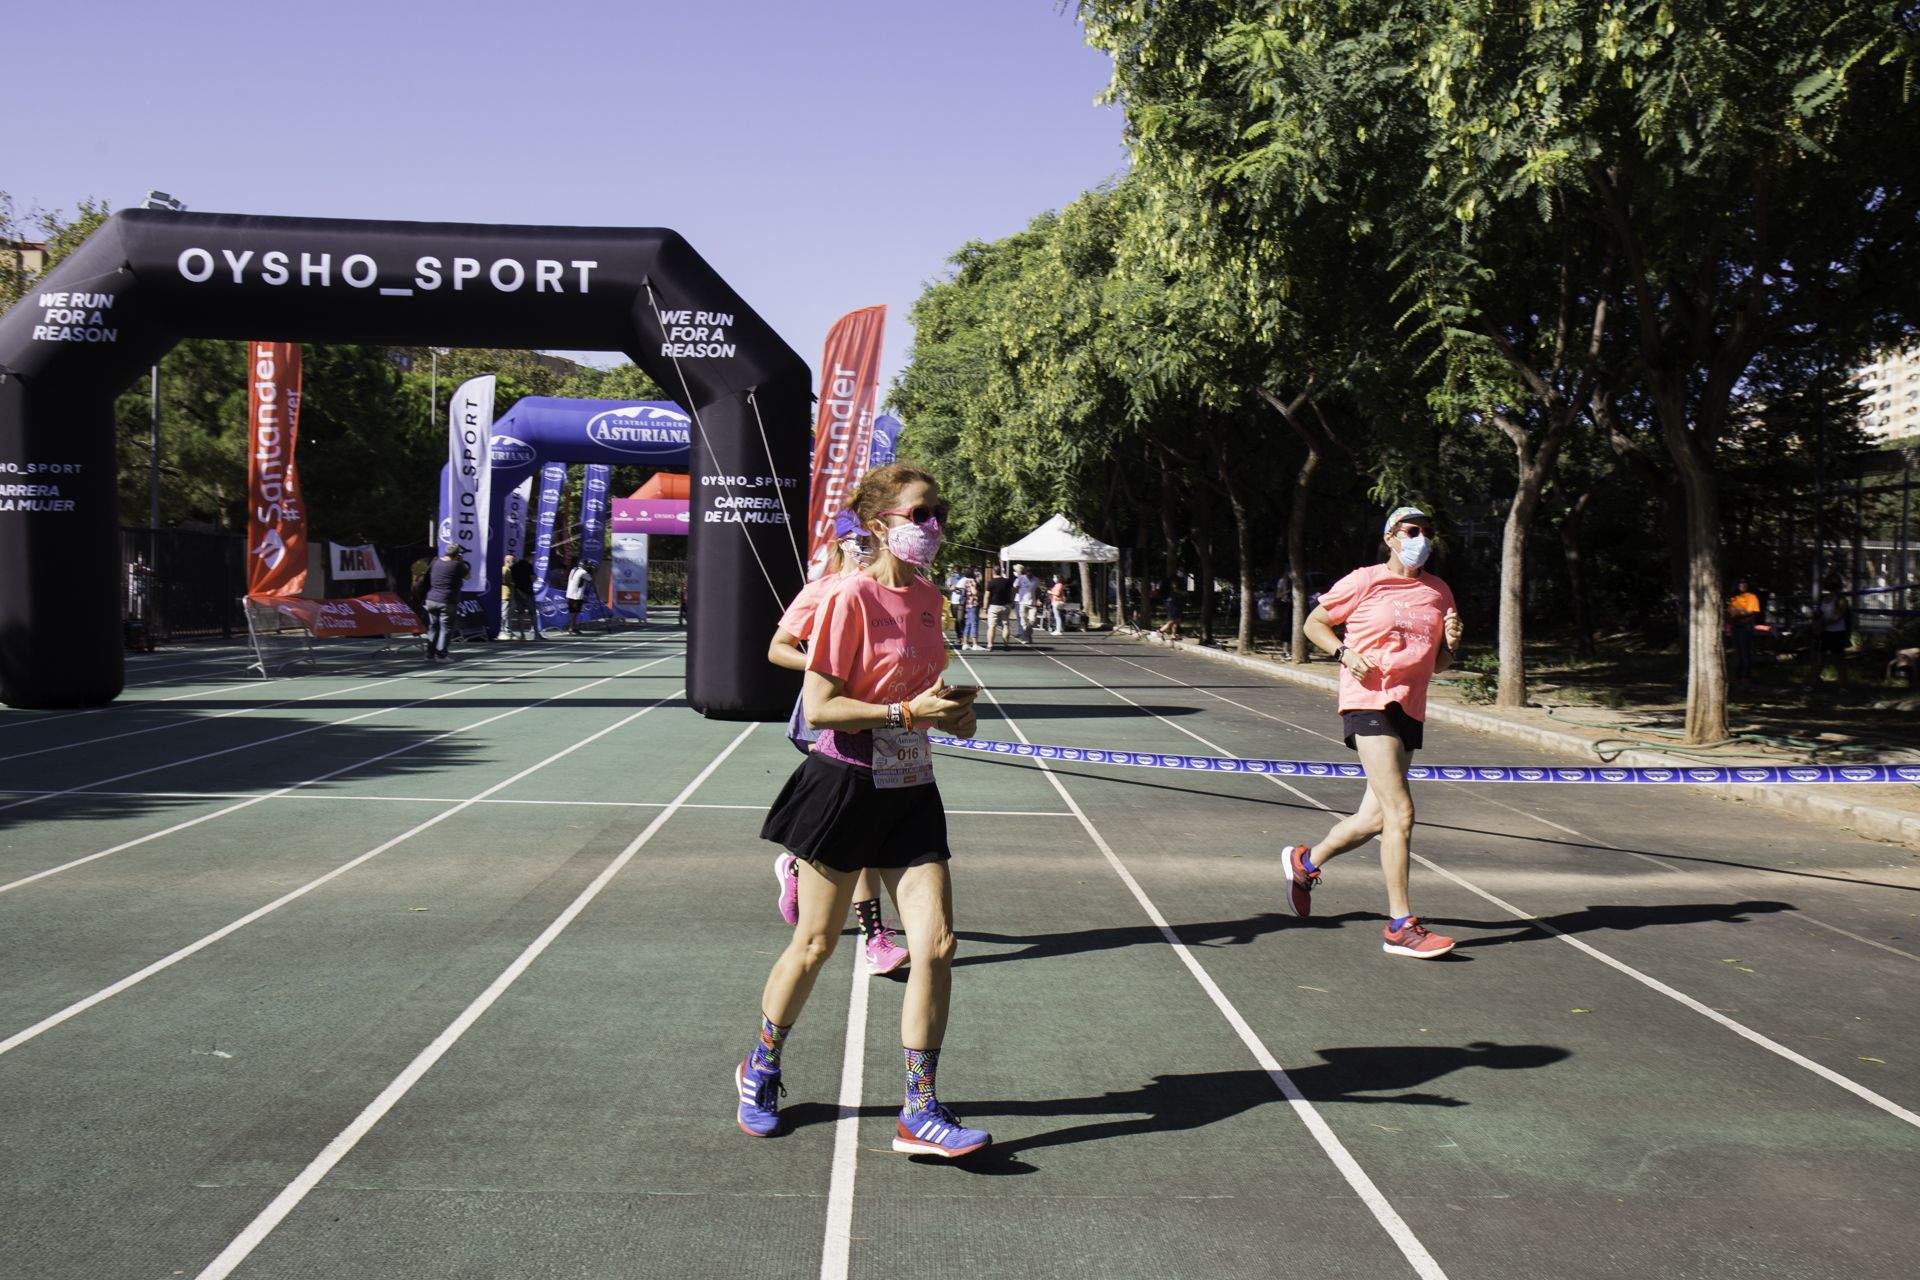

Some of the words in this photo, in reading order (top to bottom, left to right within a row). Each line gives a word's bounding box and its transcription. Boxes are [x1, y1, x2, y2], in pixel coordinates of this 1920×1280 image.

[177, 247, 598, 296] OYSHO_SPORT
[39, 292, 69, 307] WE
[70, 292, 114, 309] RUN
[44, 308, 87, 325] FOR
[88, 310, 103, 326] A
[660, 310, 692, 325] WE
[694, 311, 734, 327] RUN
[32, 325, 118, 342] REASON
[669, 326, 709, 342] FOR
[710, 327, 725, 342] A
[660, 342, 736, 358] REASON
[612, 419, 649, 427] CENTRAL
[255, 344, 282, 524] Santander
[815, 362, 856, 538] Santander
[701, 476, 798, 488] OYSHO_SPORT
[17, 499, 77, 512] MUJER
[714, 496, 781, 509] CARRERA
[704, 511, 722, 523] DE
[723, 511, 742, 523] LA
[897, 746, 920, 761] 016
